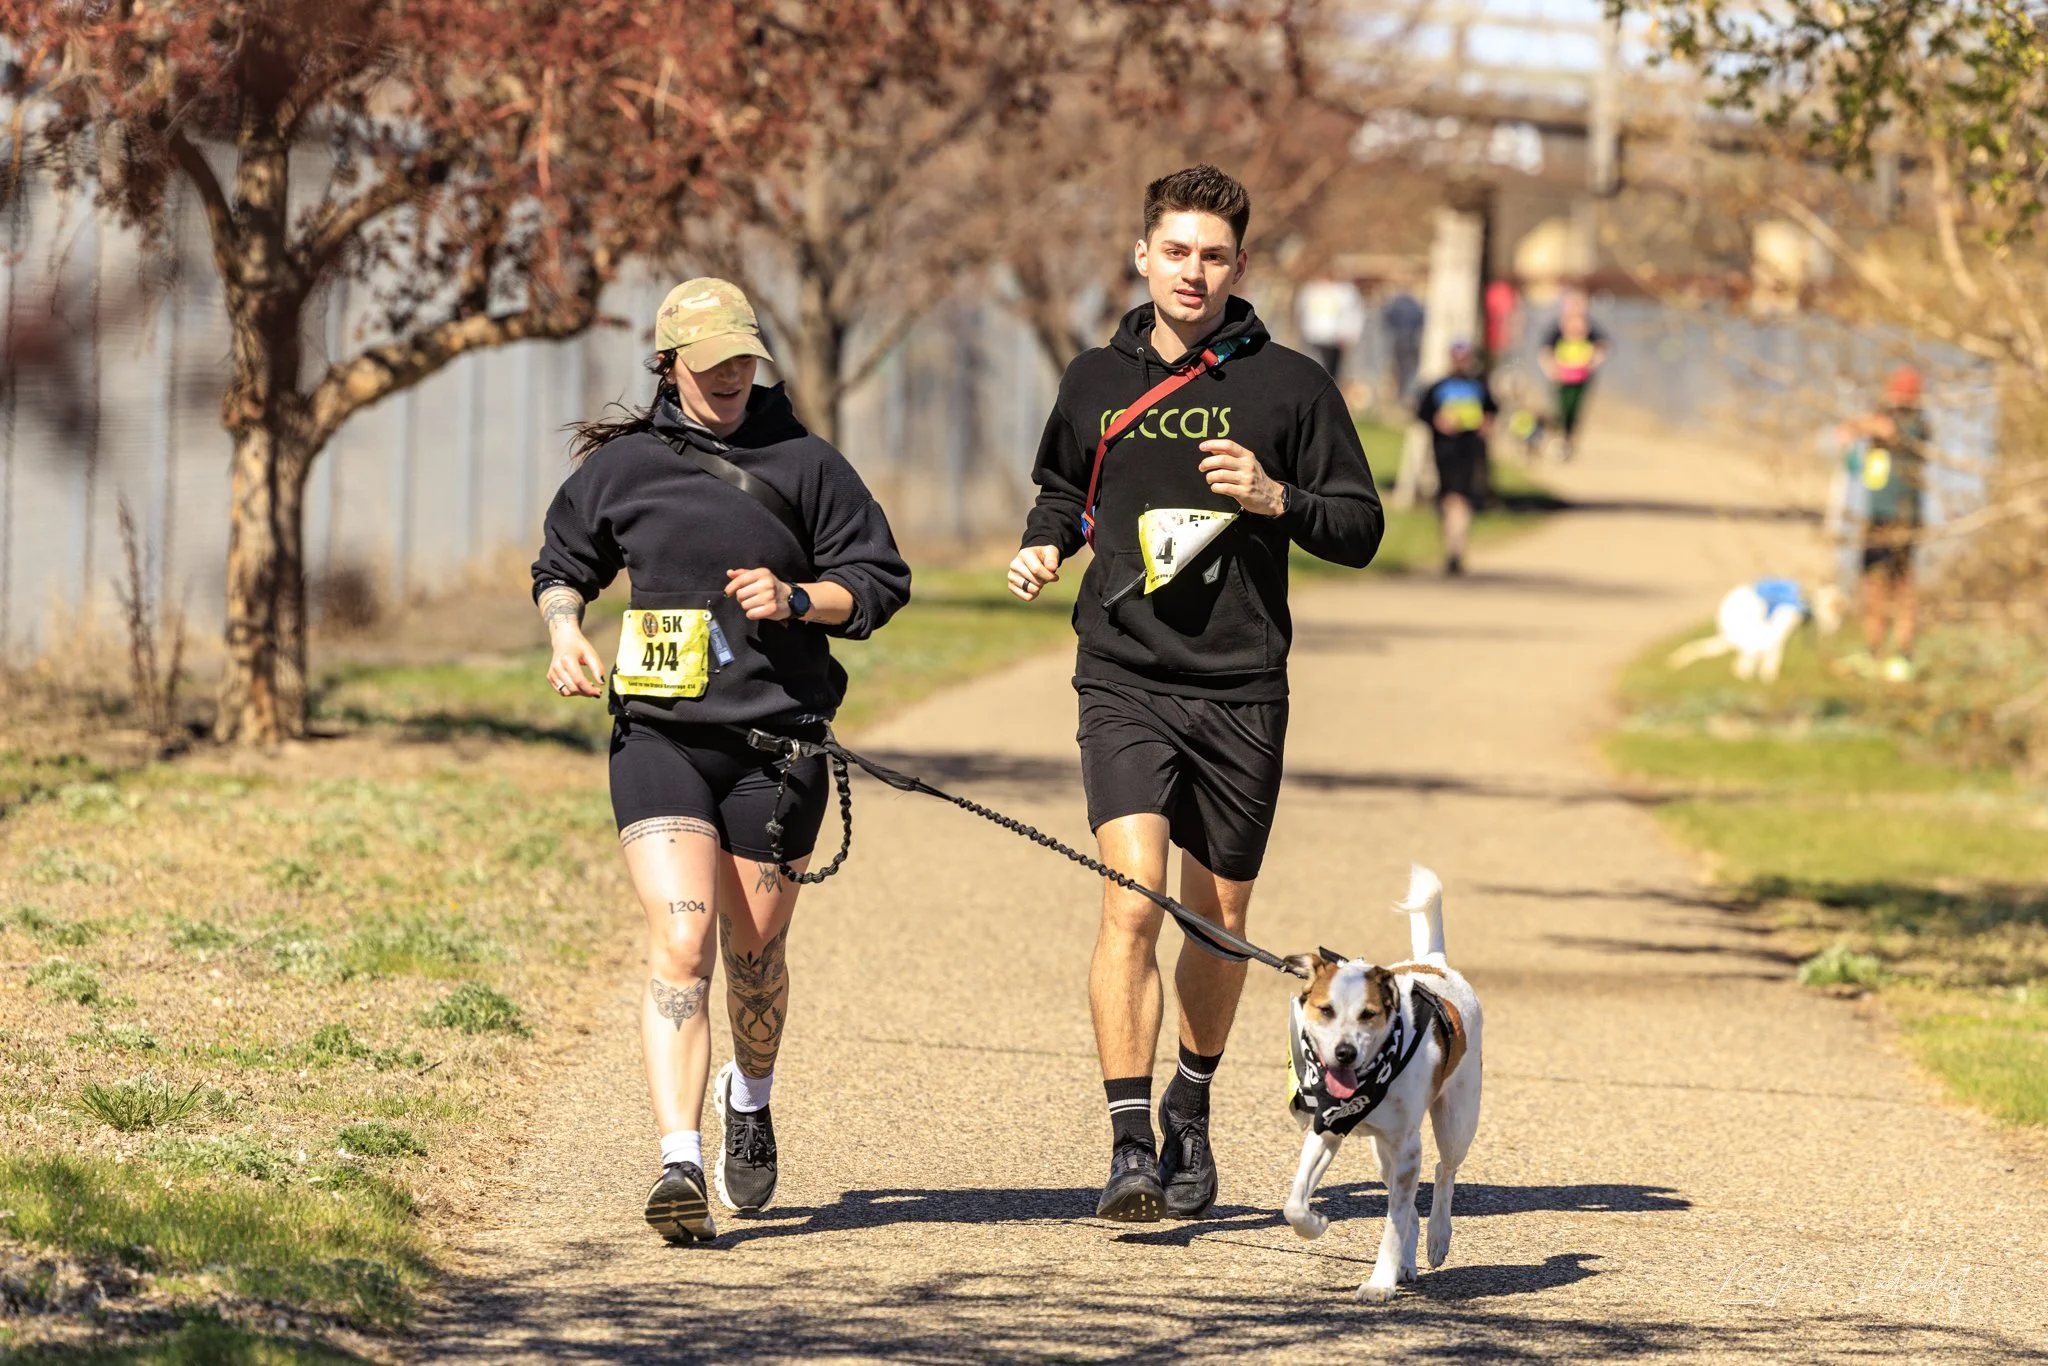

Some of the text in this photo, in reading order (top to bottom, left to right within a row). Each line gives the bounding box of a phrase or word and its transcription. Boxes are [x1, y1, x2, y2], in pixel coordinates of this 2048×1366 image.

[1156, 537, 1177, 565] 4
[663, 615, 683, 633] 5K
[641, 641, 679, 672] 414
[668, 900, 707, 914] 1204
